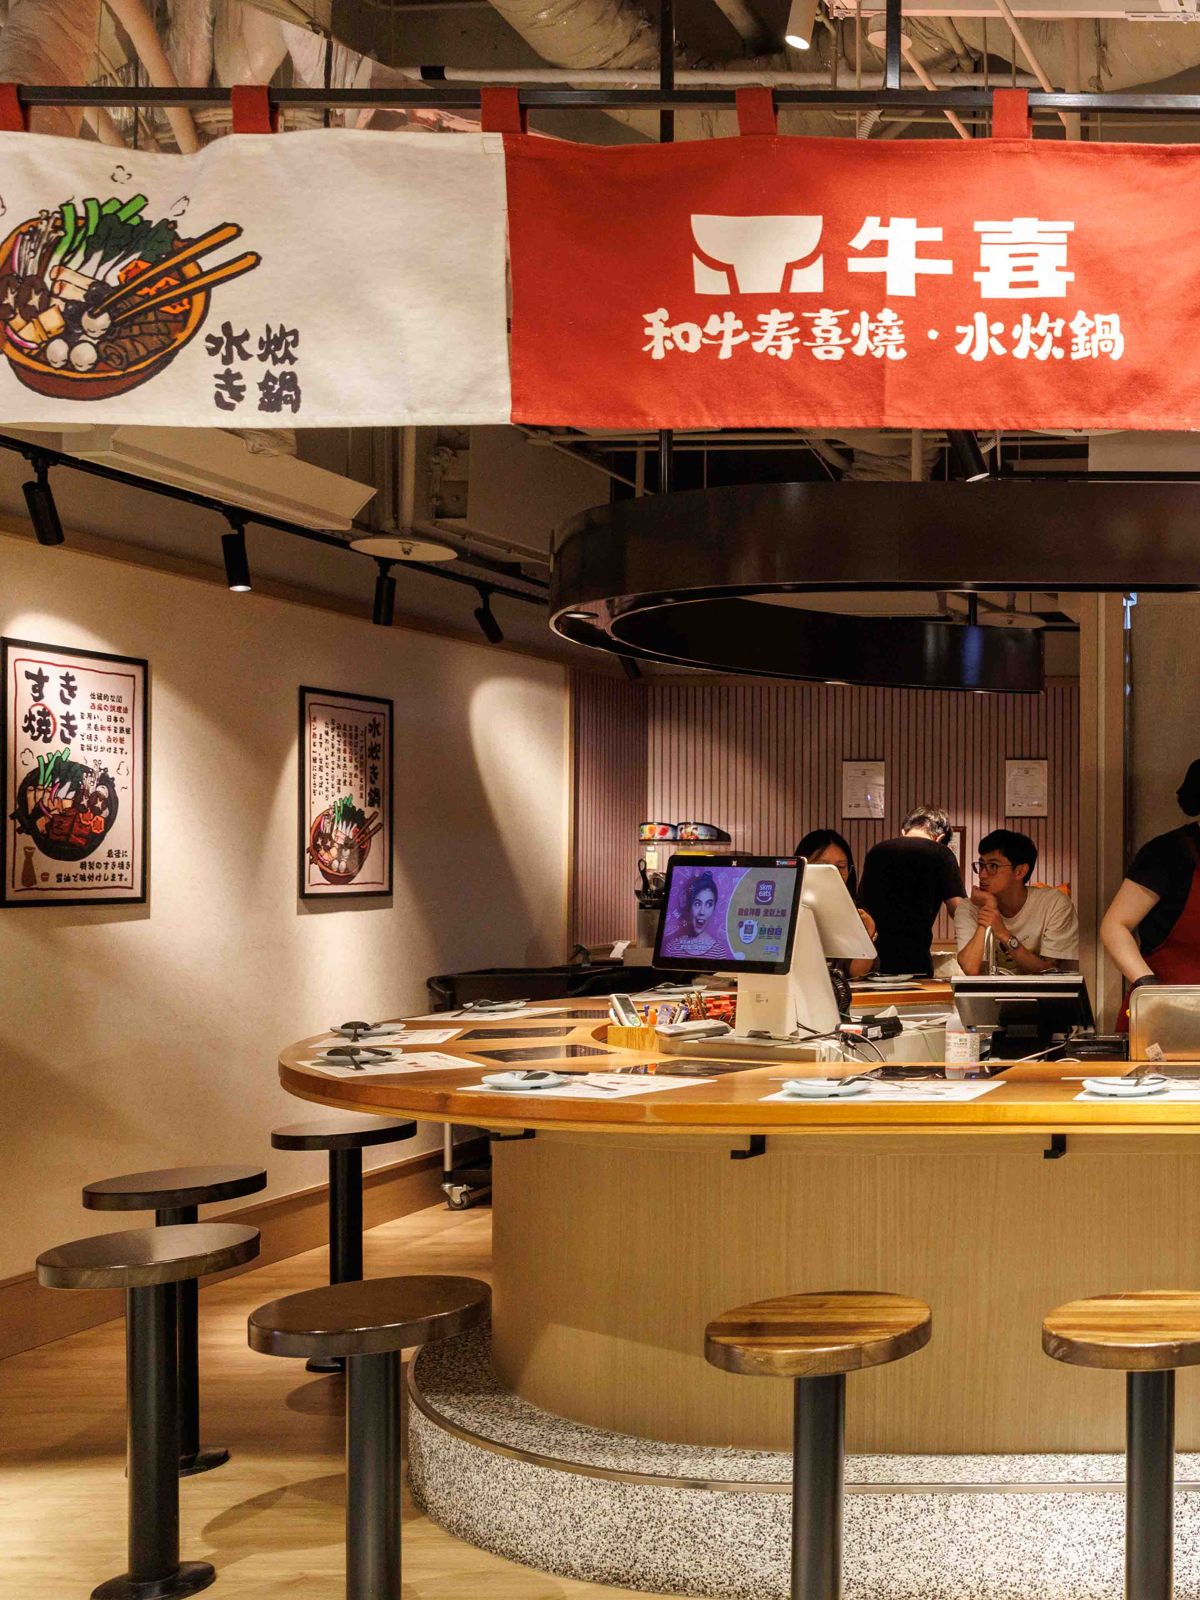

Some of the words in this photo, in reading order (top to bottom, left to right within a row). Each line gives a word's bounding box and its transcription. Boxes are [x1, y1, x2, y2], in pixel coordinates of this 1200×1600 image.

[848, 216, 1076, 299] 牛喜
[24, 667, 78, 705] すき
[21, 707, 79, 745] 焼き
